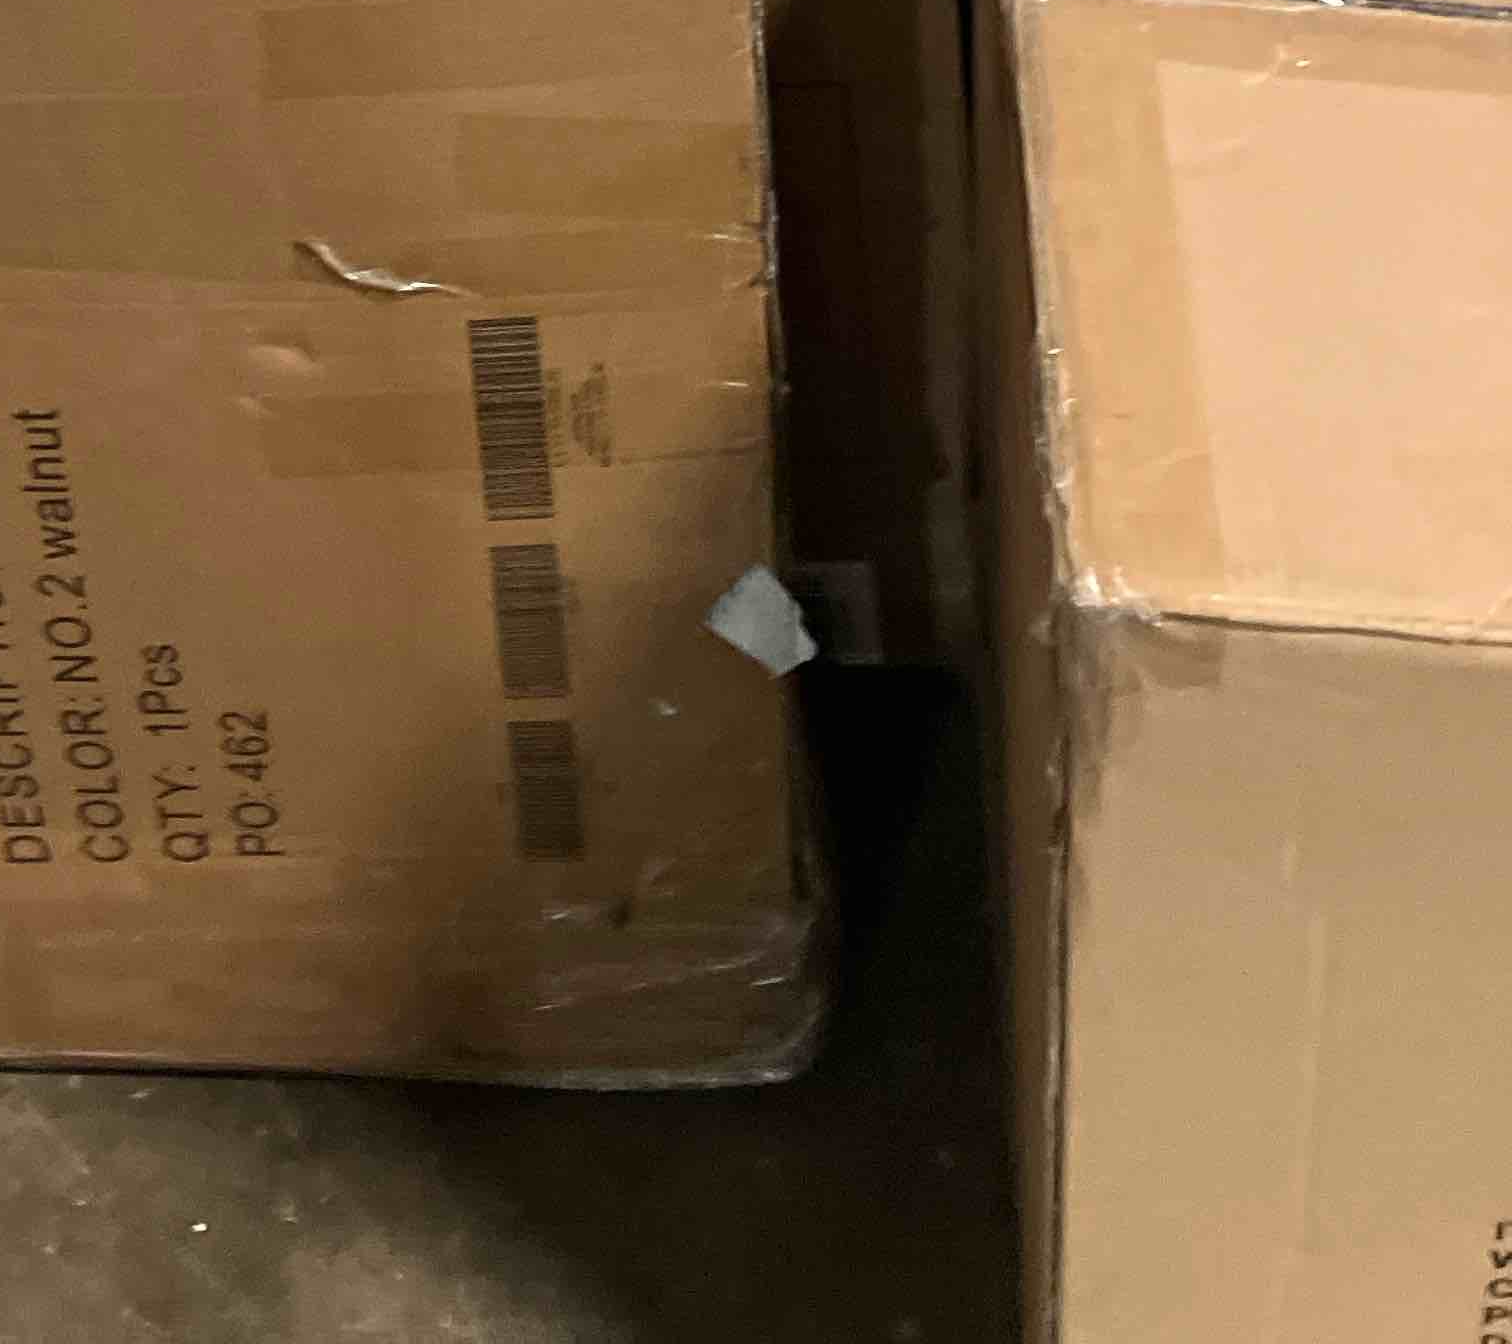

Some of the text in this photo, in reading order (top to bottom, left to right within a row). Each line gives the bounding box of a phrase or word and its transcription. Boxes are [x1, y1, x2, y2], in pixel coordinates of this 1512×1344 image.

[10, 408, 80, 560] walnut
[59, 694, 130, 864] COLOR:
[137, 643, 211, 864] QTY: 1Pcs
